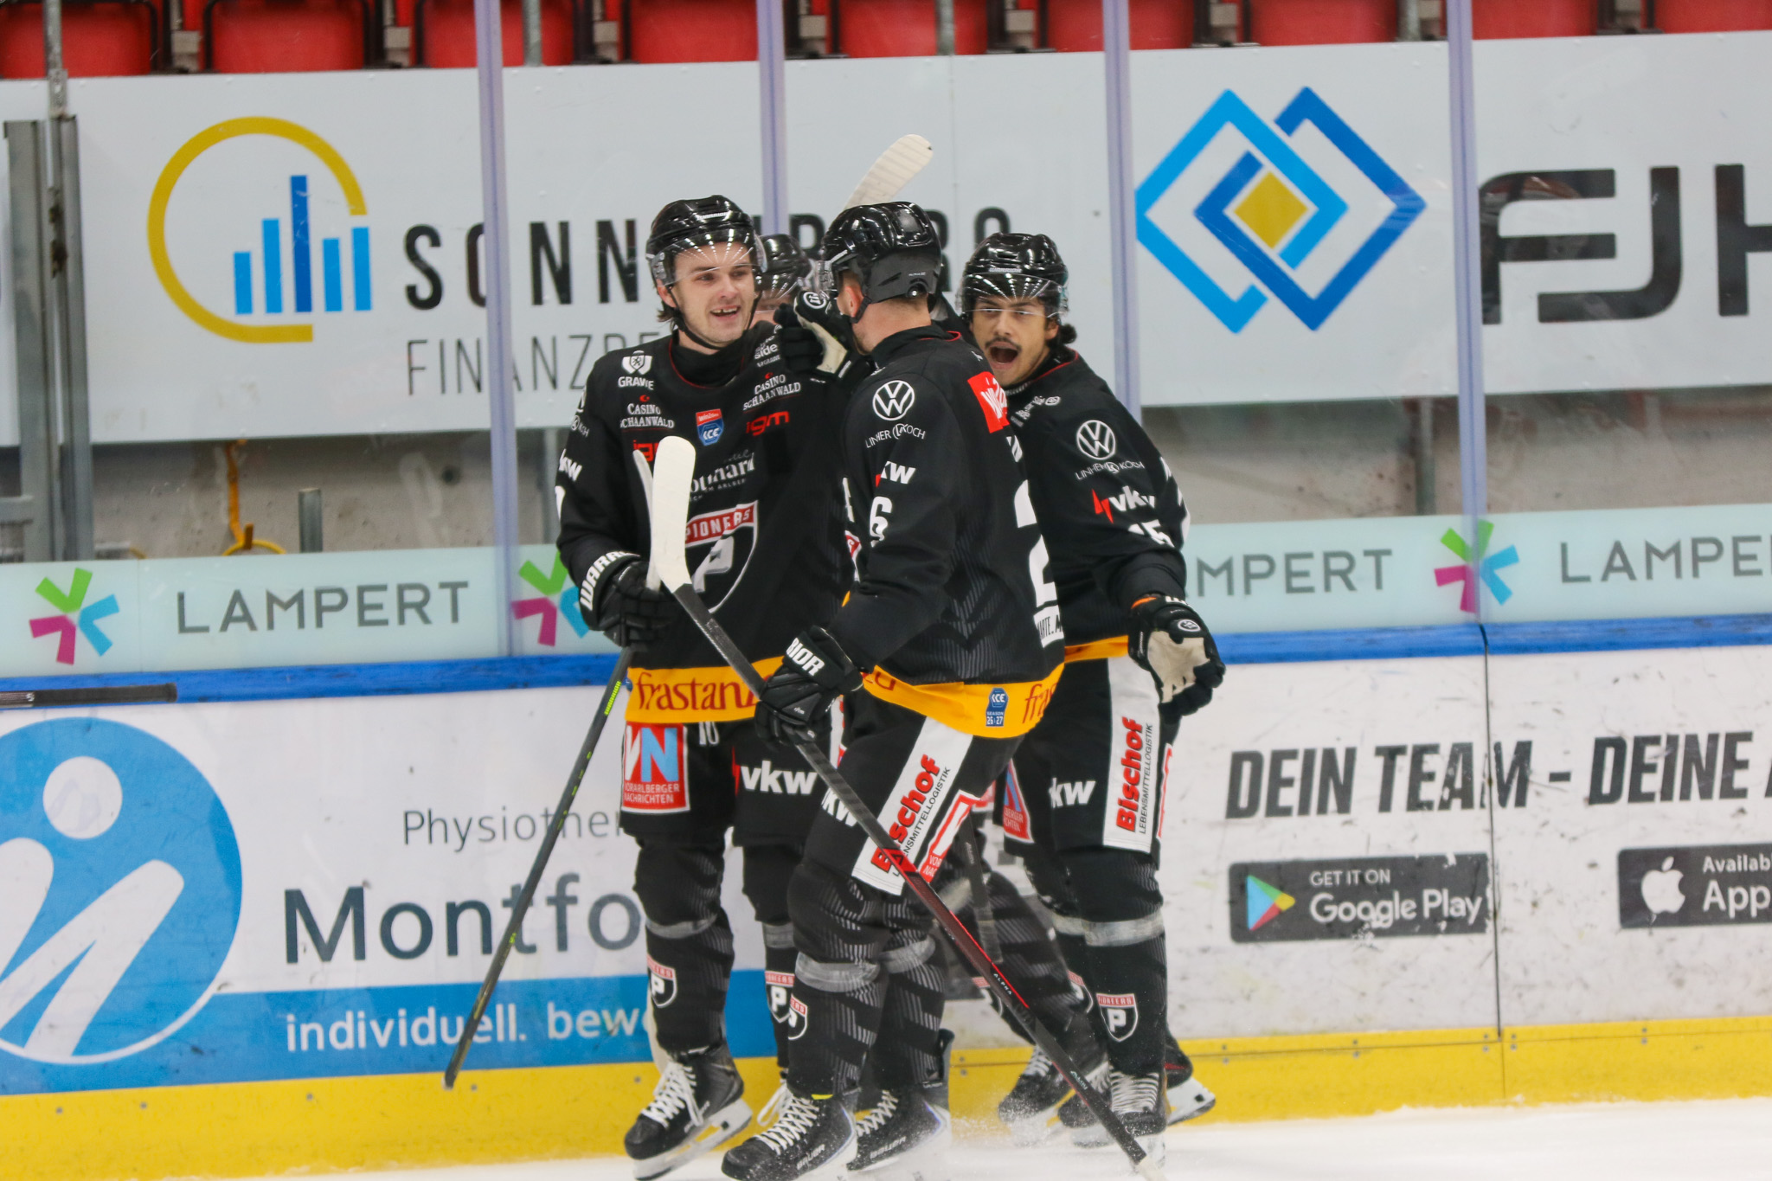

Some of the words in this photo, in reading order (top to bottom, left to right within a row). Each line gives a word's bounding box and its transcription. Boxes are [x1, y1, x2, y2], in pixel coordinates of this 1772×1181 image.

[743, 382, 802, 411] SCHAANWALD
[754, 374, 786, 395] CASINO
[1184, 549, 1392, 598] MPERT
[1560, 535, 1772, 583] LAMPE
[176, 581, 469, 634] LAMPERT
[740, 760, 817, 795] vkw
[1116, 716, 1143, 832] Bischof
[1139, 723, 1153, 834] LEBENSMITTELLOGISTIK
[1225, 747, 1357, 819] DEIN
[1375, 741, 1533, 813] TEAM
[1588, 731, 1753, 805] DEINE
[1310, 871, 1342, 887] GET
[1346, 871, 1361, 885] IT
[1365, 869, 1391, 885] ON
[1703, 853, 1772, 873] Availab
[1310, 891, 1417, 928] Google
[1423, 889, 1482, 925] Play
[1703, 880, 1771, 919] App
[286, 1003, 526, 1052] individuell.
